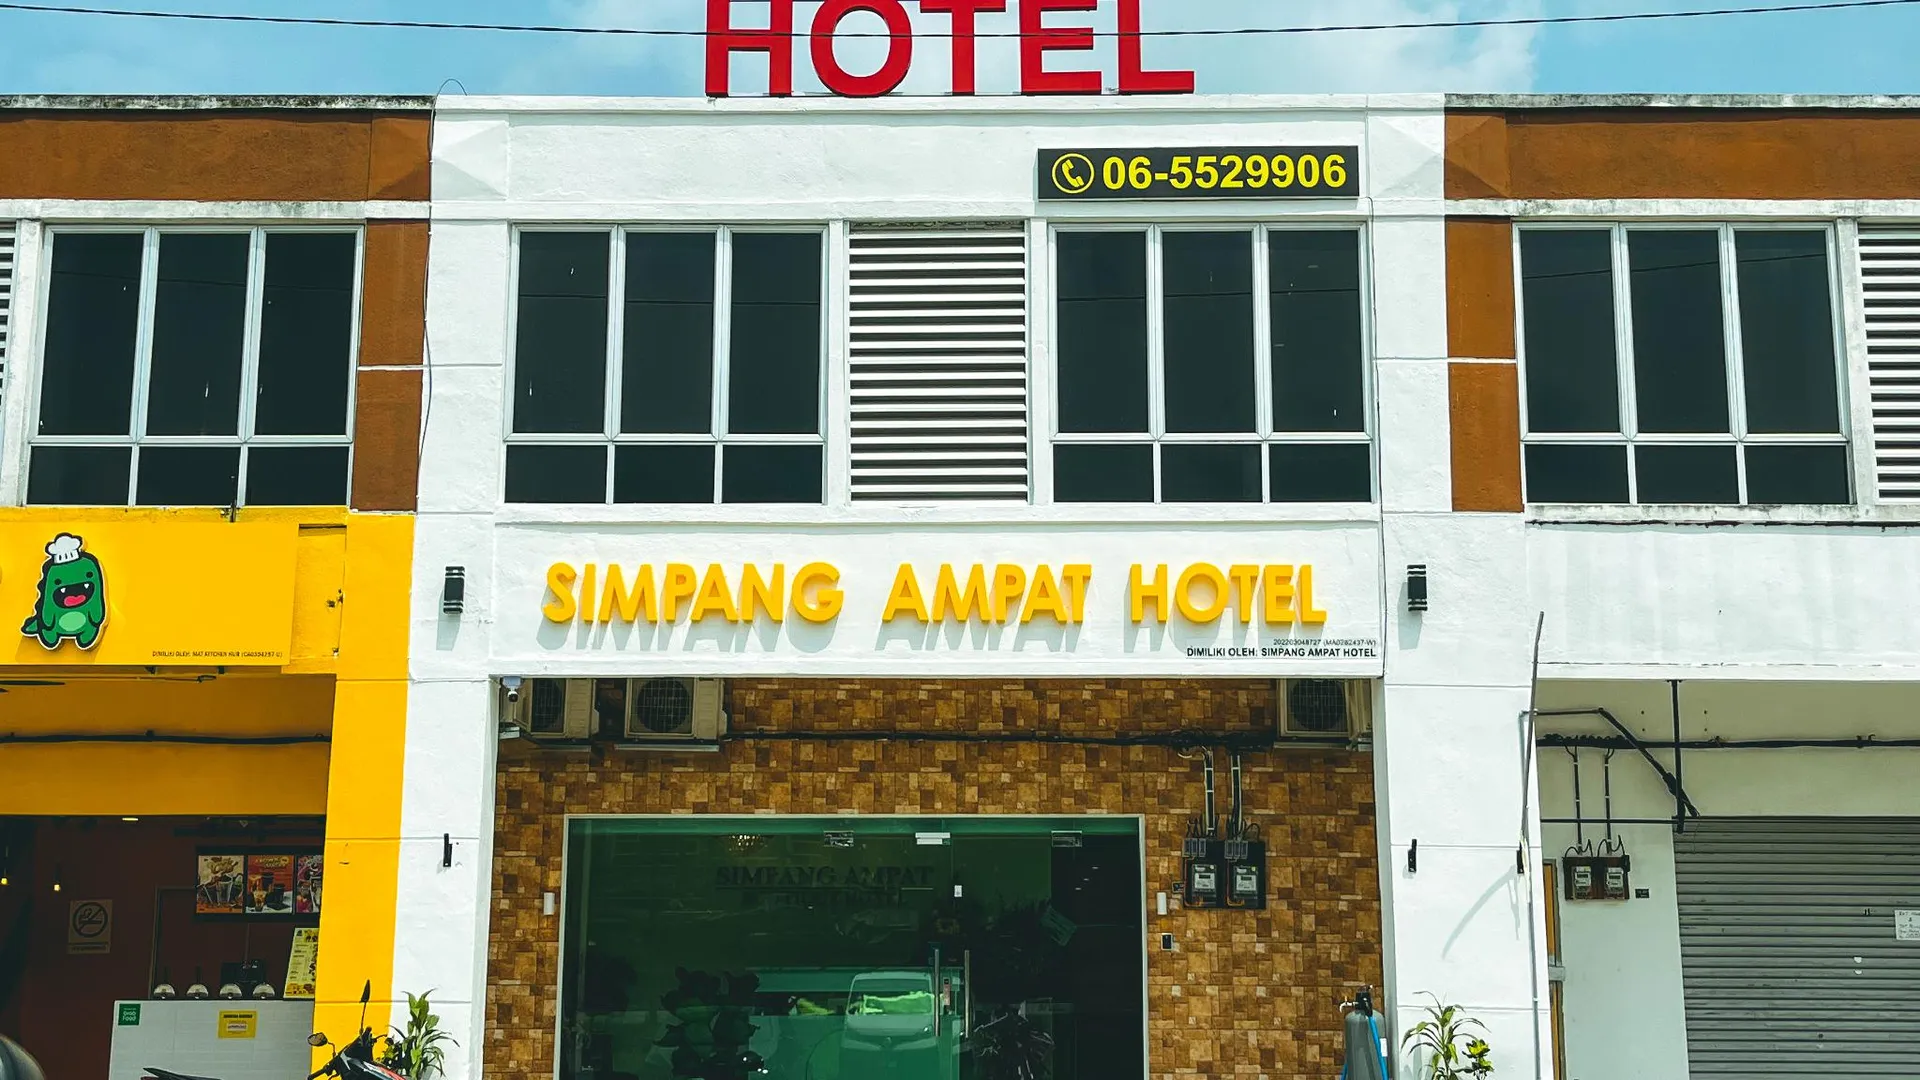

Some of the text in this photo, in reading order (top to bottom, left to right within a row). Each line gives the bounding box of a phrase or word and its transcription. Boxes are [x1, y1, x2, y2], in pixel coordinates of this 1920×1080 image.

[705, 0, 1195, 97] HOTEL
[1102, 154, 1347, 190] 06-5529906
[542, 562, 1327, 625] SIMPANG AMPAT HOTEL
[1186, 647, 1377, 657] DIMILIKI OLEH: SIMPANG AMPAT HOTEL
